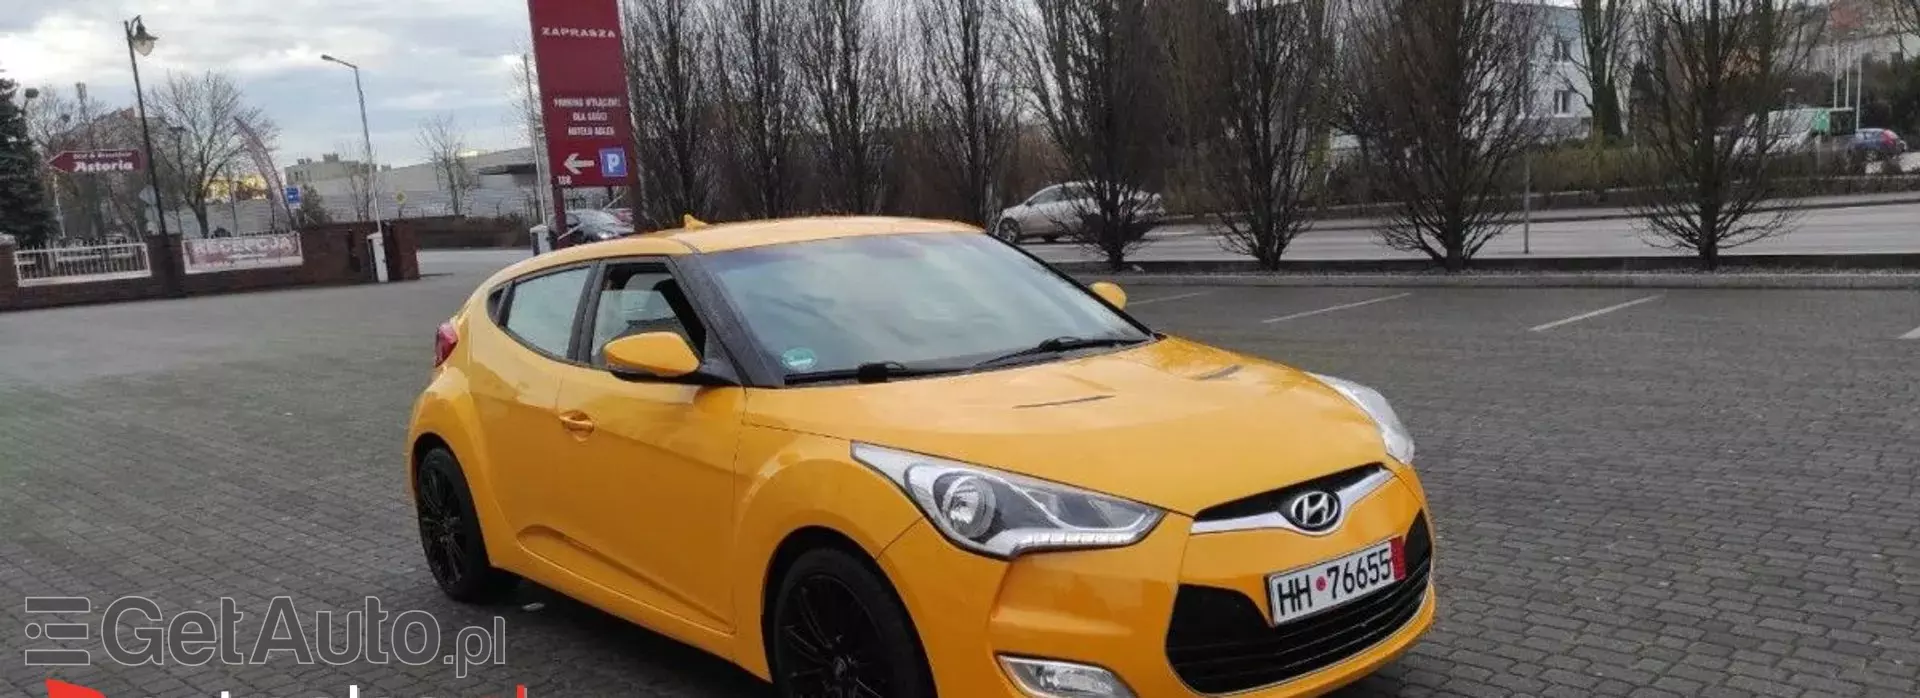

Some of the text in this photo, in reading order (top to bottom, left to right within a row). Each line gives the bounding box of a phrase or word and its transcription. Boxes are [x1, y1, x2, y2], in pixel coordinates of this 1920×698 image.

[542, 26, 616, 38] ZAPRASZA
[73, 159, 134, 173] Astoria
[1277, 548, 1392, 616] HH 76655
